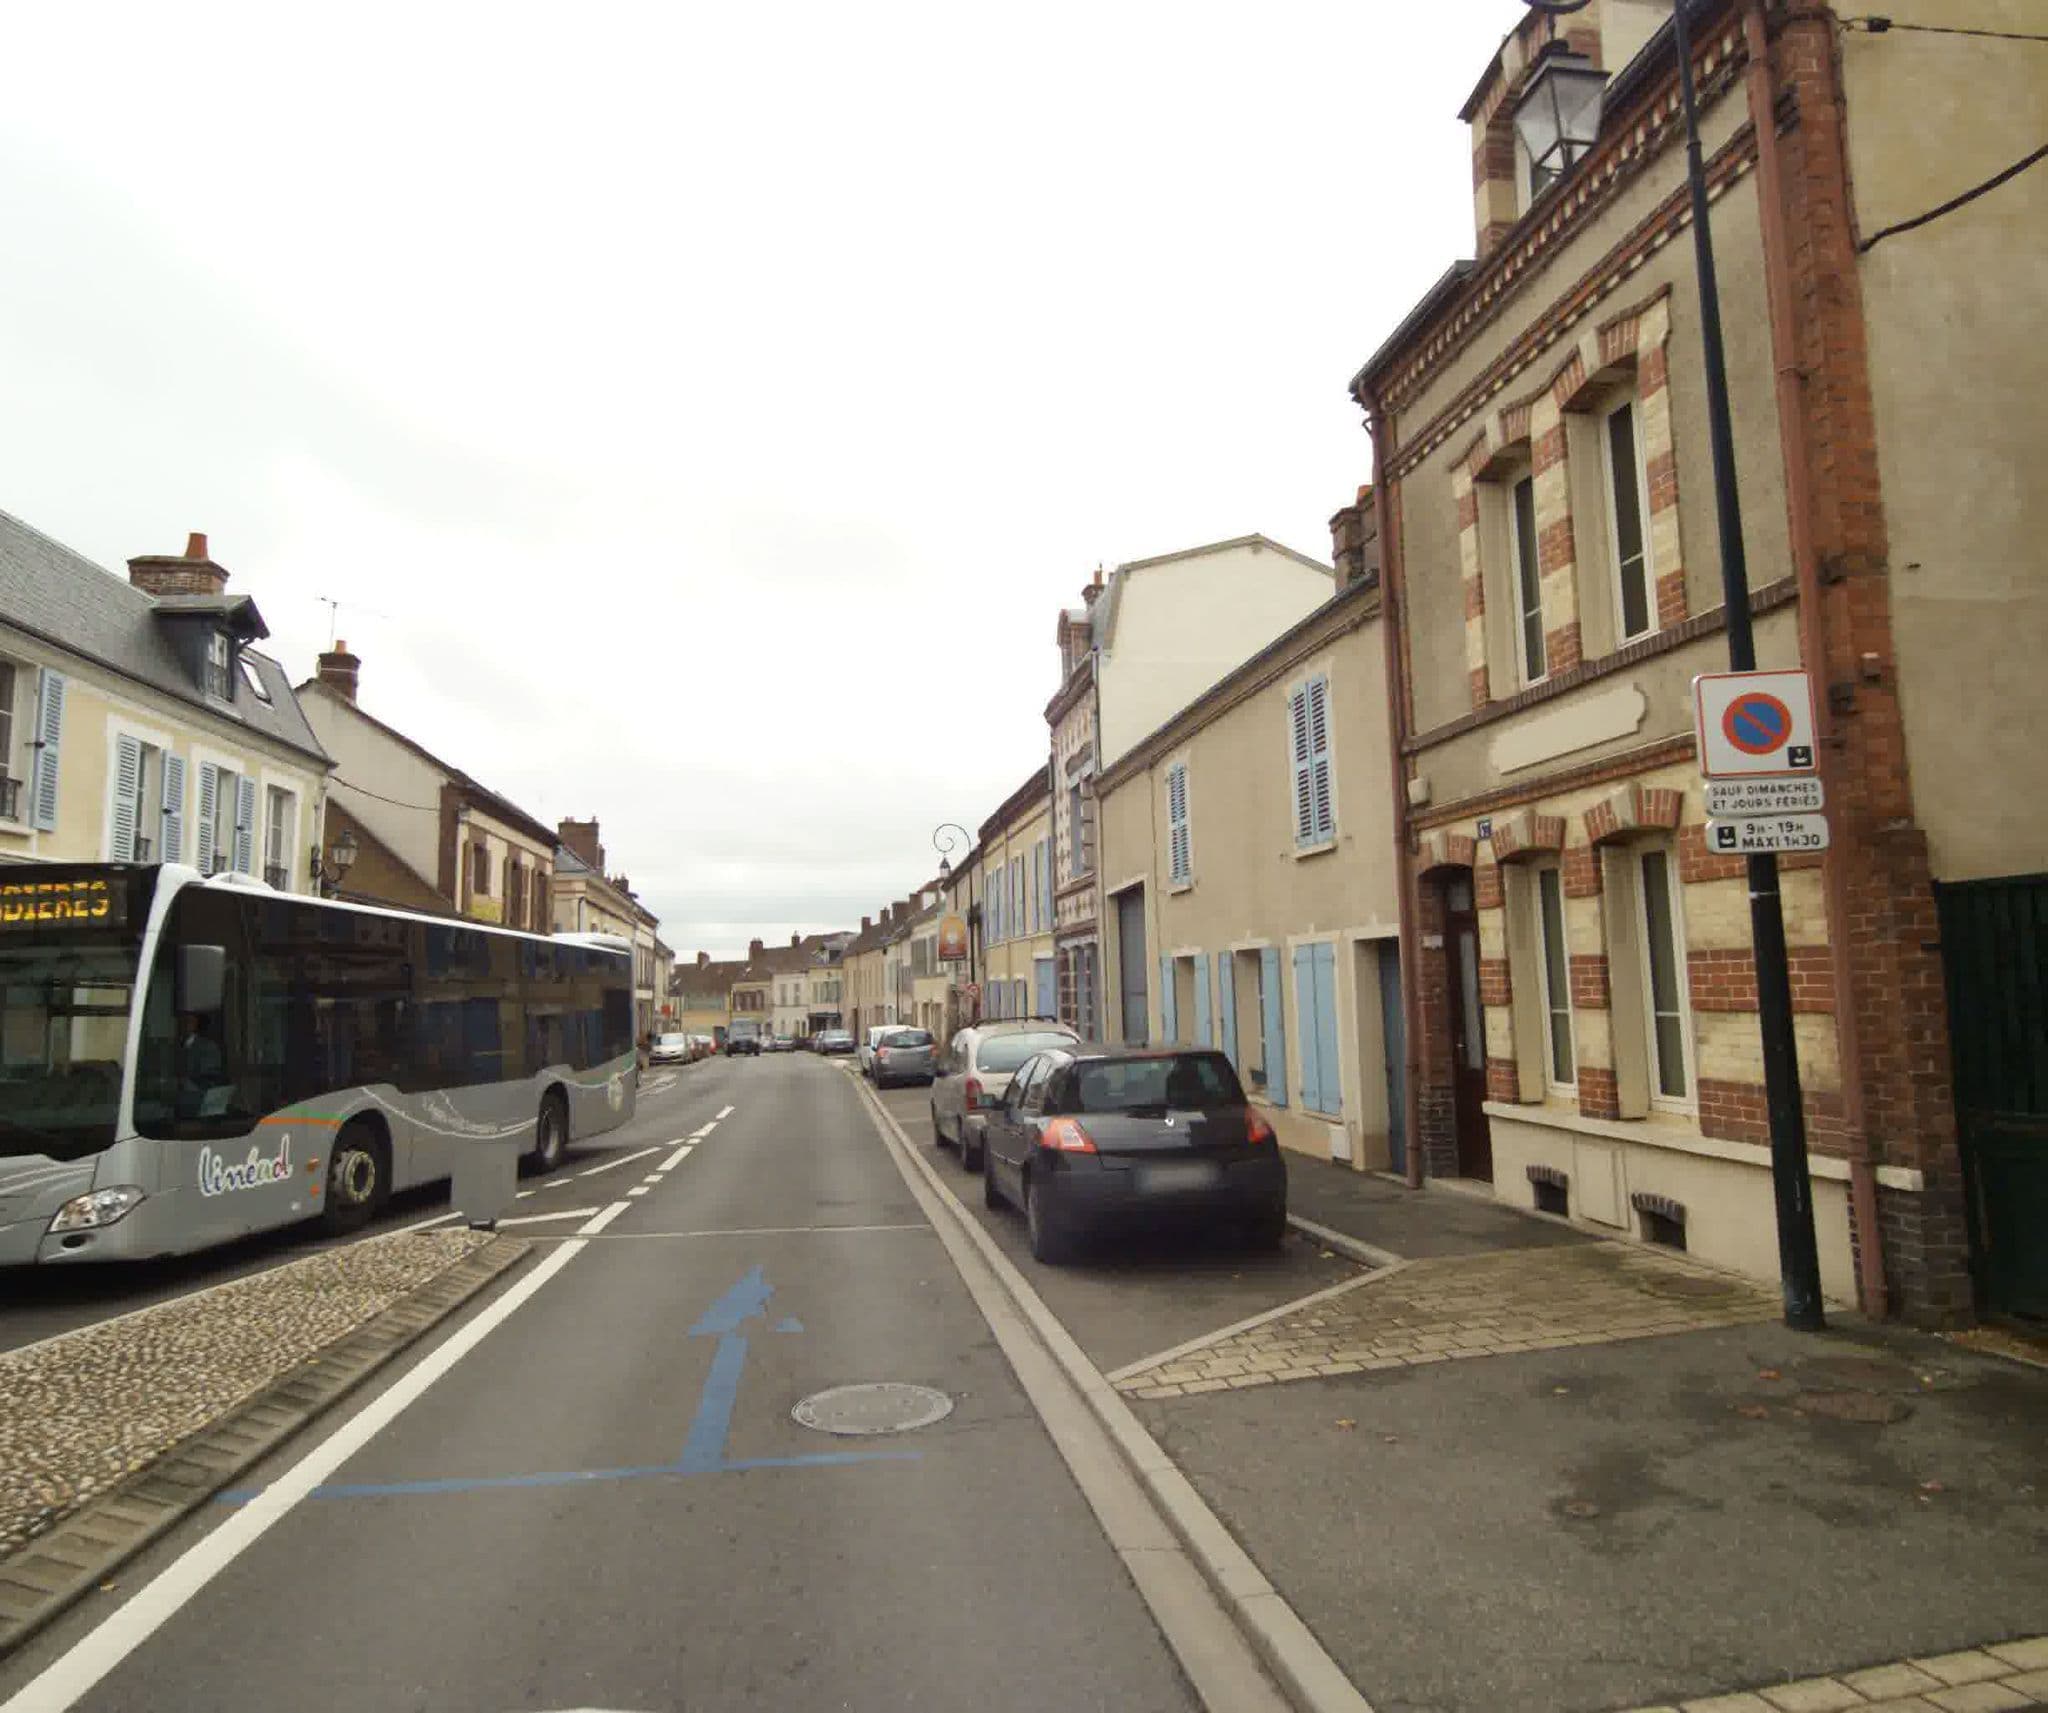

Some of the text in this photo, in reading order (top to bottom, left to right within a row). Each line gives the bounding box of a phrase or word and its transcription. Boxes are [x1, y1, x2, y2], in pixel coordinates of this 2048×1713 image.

[1712, 783, 1818, 797] SAUF DIMANCHES
[1712, 799, 1726, 810] ET
[1732, 798, 1772, 809] JOURS
[1742, 836, 1780, 849] MAXI
